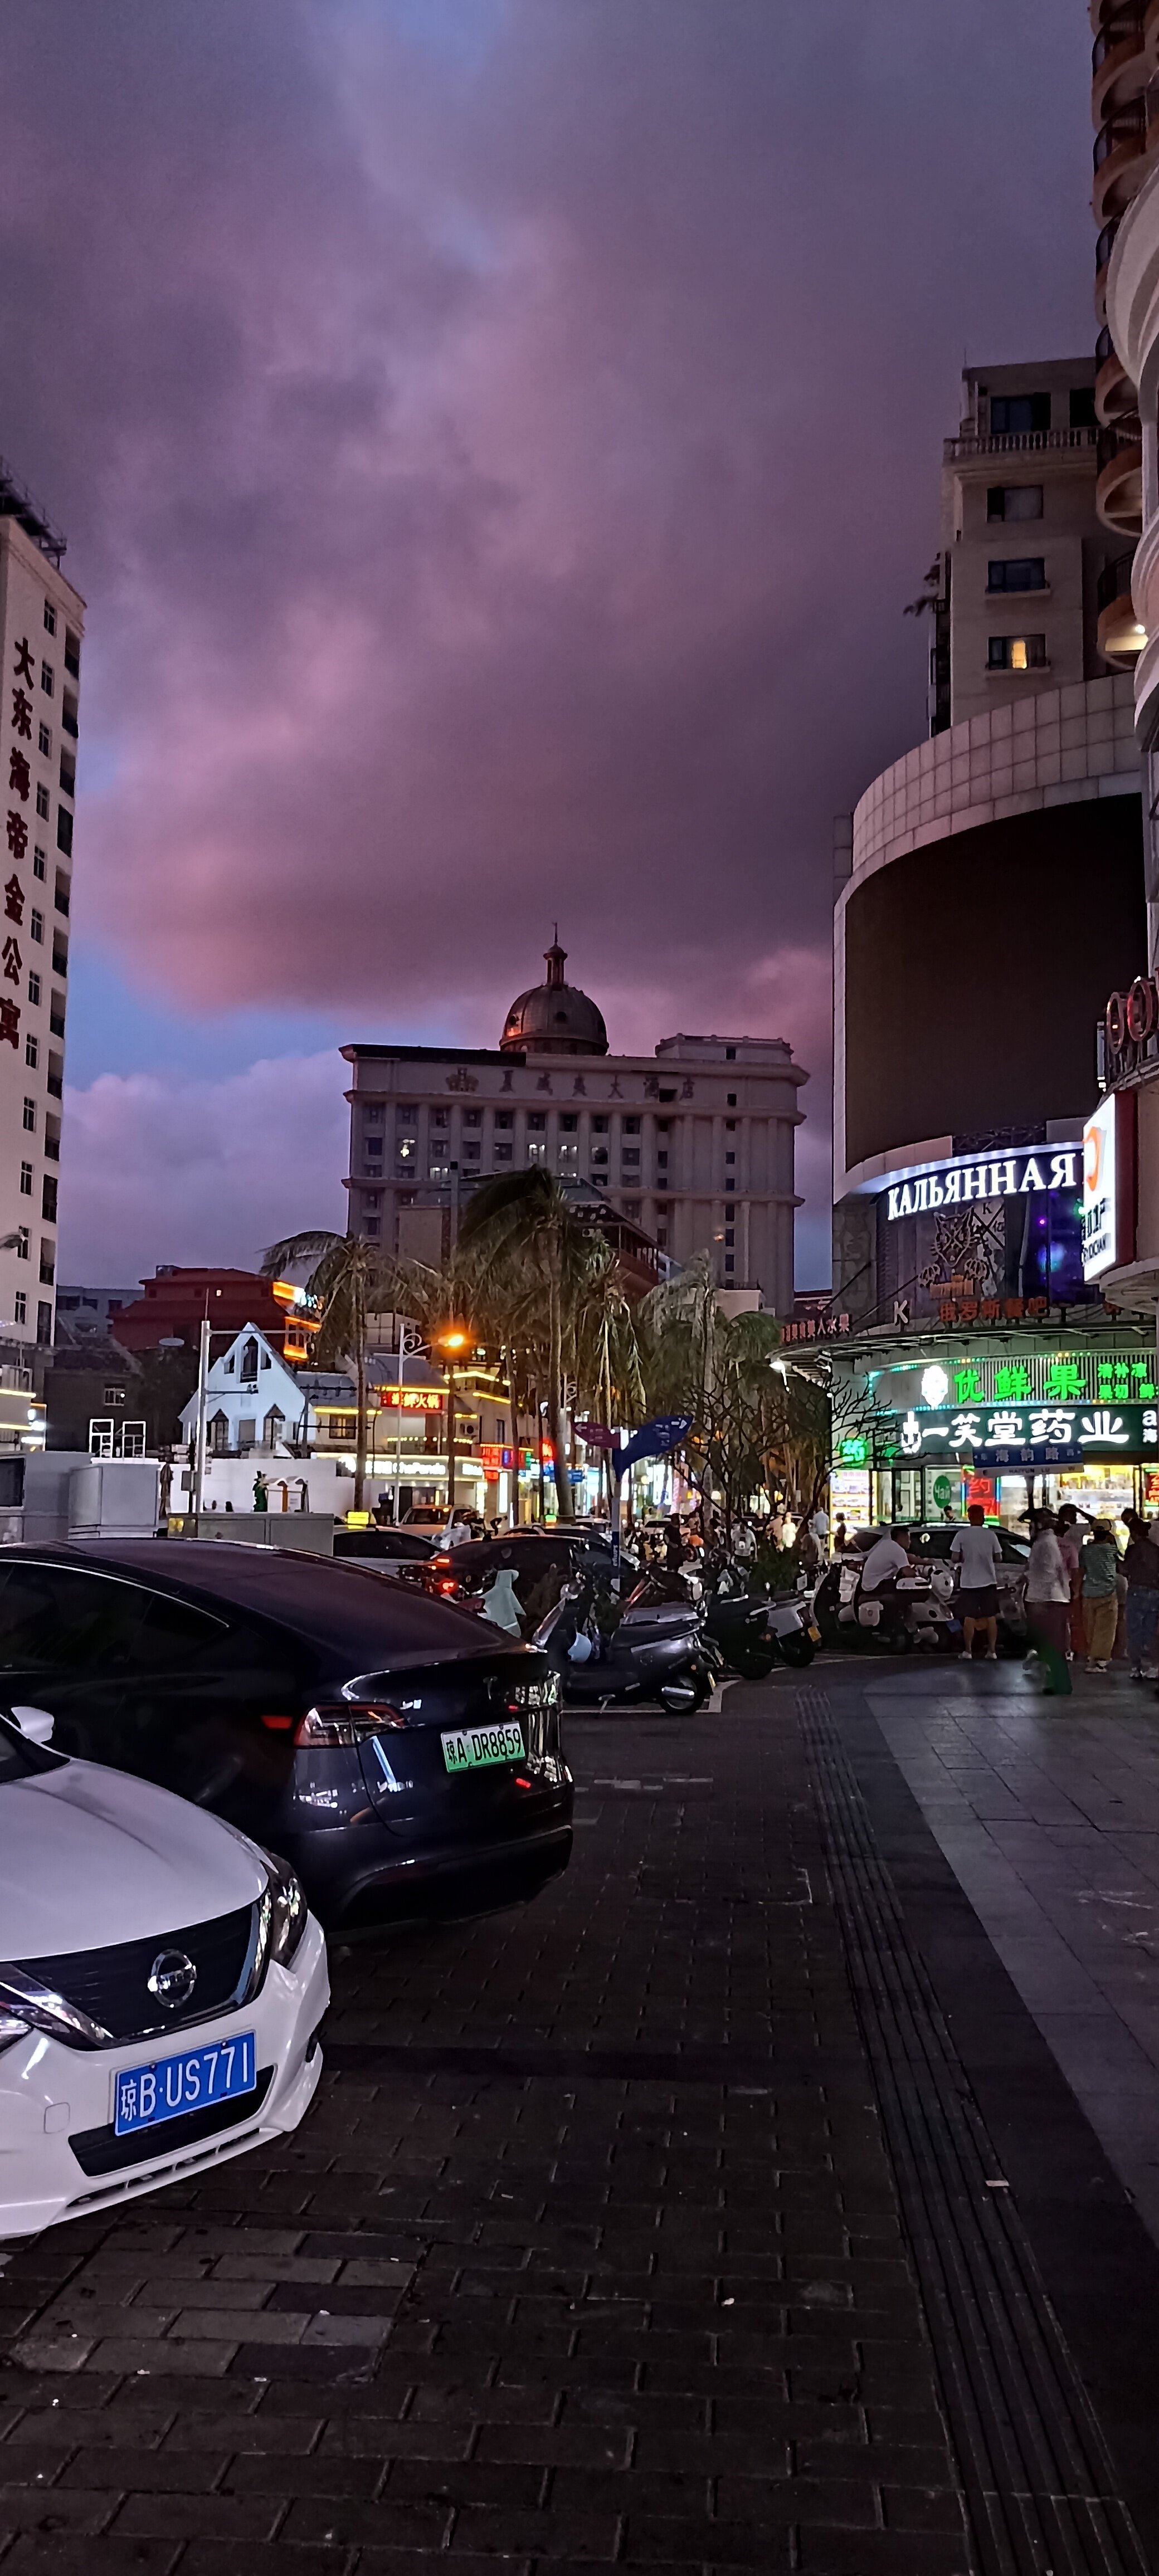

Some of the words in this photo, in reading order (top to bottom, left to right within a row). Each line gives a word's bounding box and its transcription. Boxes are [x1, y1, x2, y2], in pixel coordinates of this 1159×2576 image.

[0, 637, 35, 1050] 大东海帝金公寓
[888, 1153, 1077, 1221] КАЛЬЯННАЯ
[940, 1297, 1047, 1322] 俄罗斯餐吧
[955, 1363, 1087, 1403] 优鲜果
[922, 1408, 1130, 1447] 一笑堂药业
